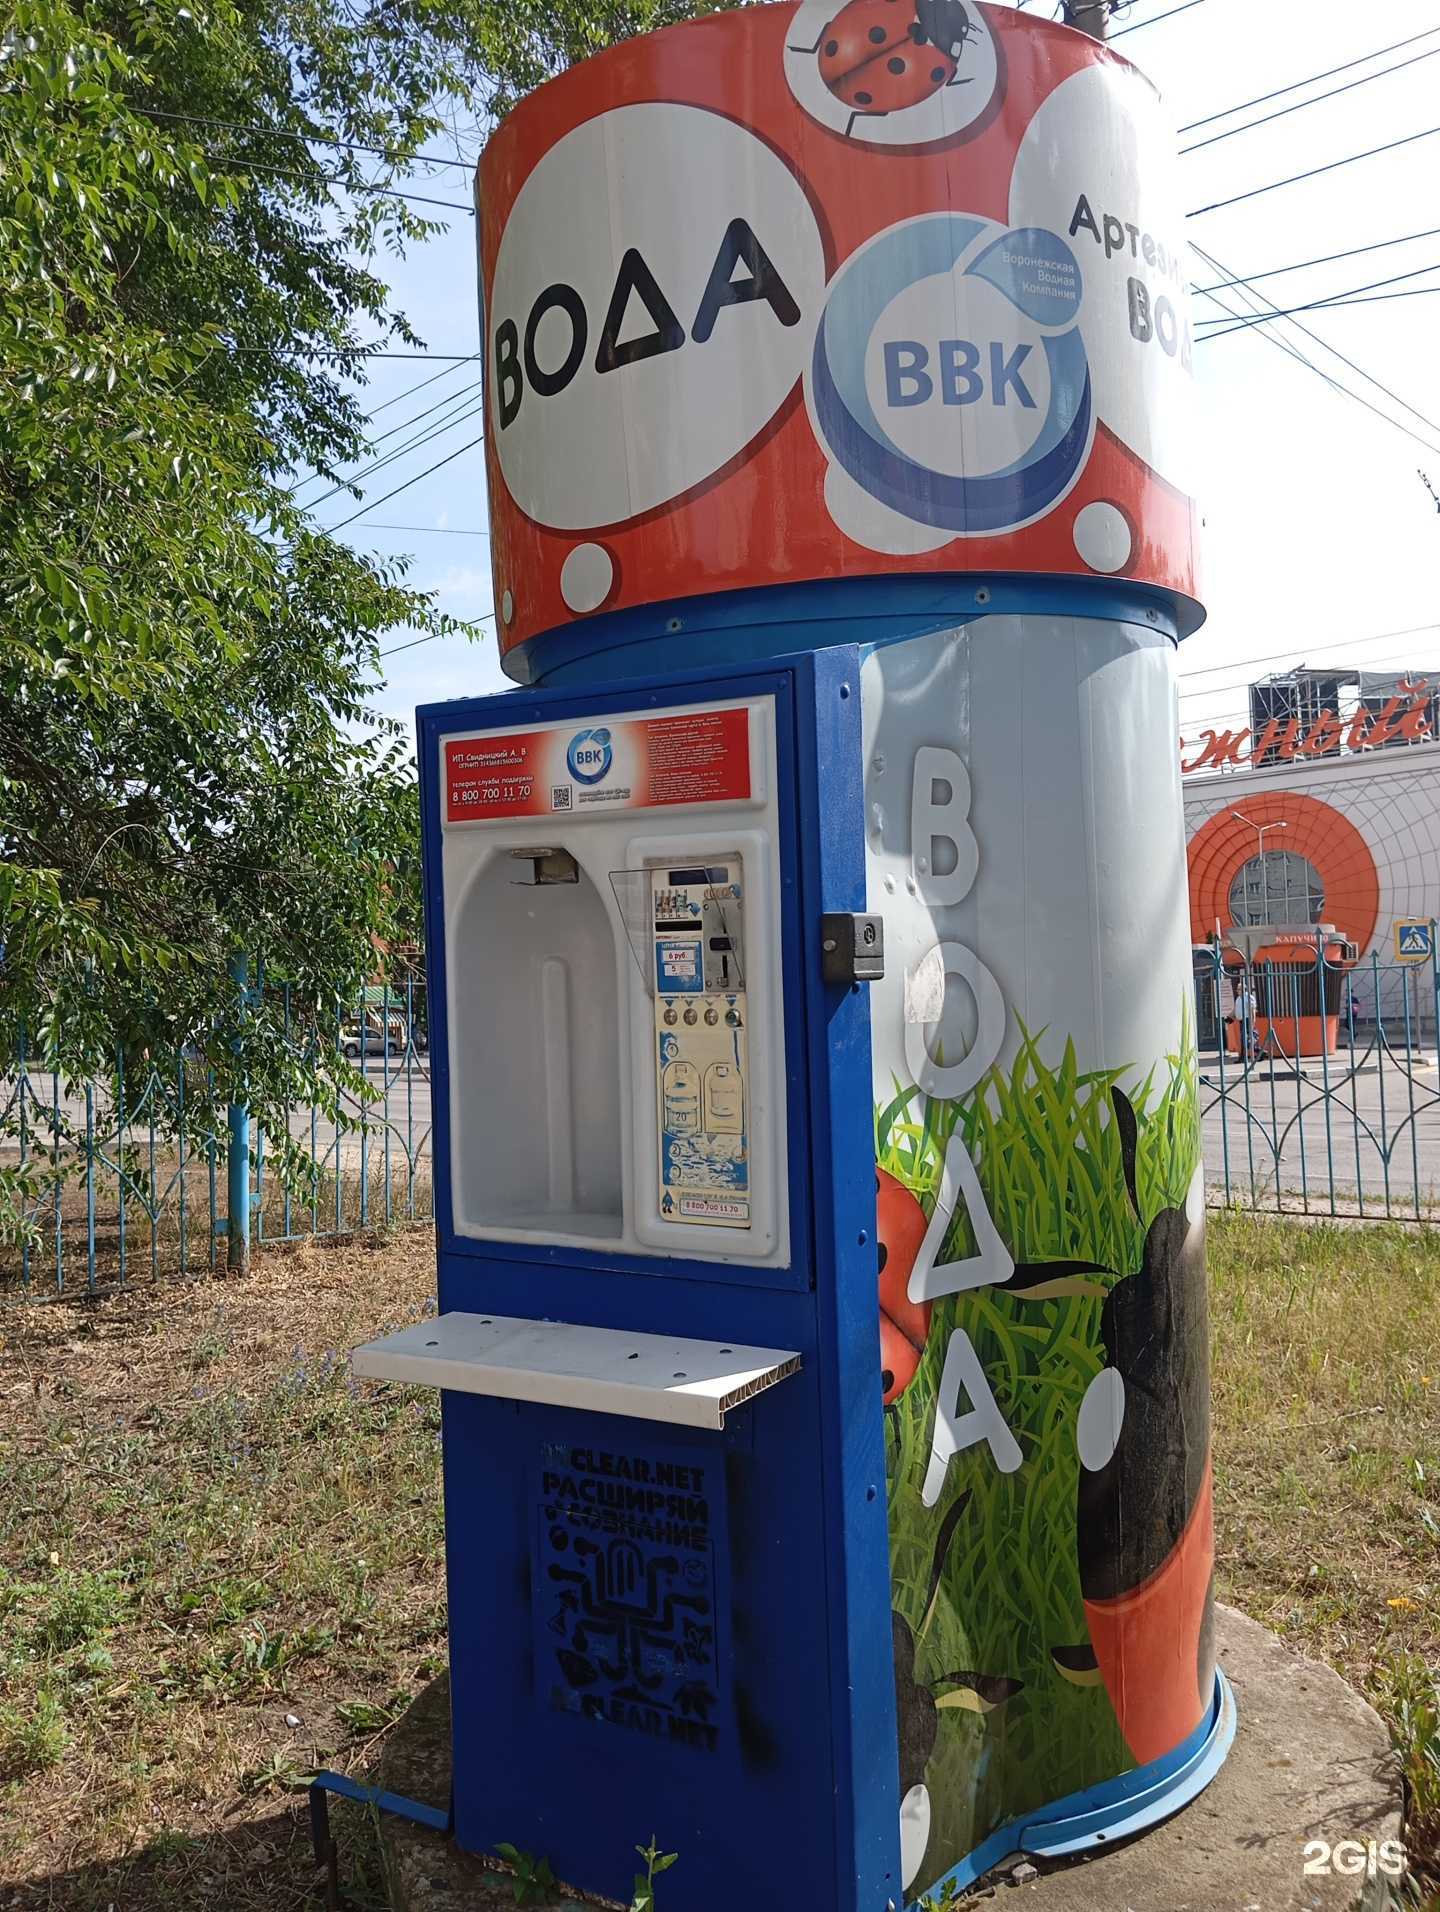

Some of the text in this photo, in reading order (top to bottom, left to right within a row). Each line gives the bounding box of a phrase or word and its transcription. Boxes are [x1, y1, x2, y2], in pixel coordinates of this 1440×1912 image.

[1002, 251, 1075, 273] Воронежская
[1038, 270, 1075, 286] Водная
[1023, 280, 1076, 299] Компания
[495, 217, 801, 431] ВОДА
[882, 340, 1037, 410] ВВК
[1180, 677, 1433, 773] жный
[452, 753, 464, 762] ИП
[576, 749, 602, 764] ВВК
[478, 777, 500, 786] службы
[452, 784, 531, 801] 8 800 700 11 70
[1275, 933, 1329, 944] КАПУЧИО
